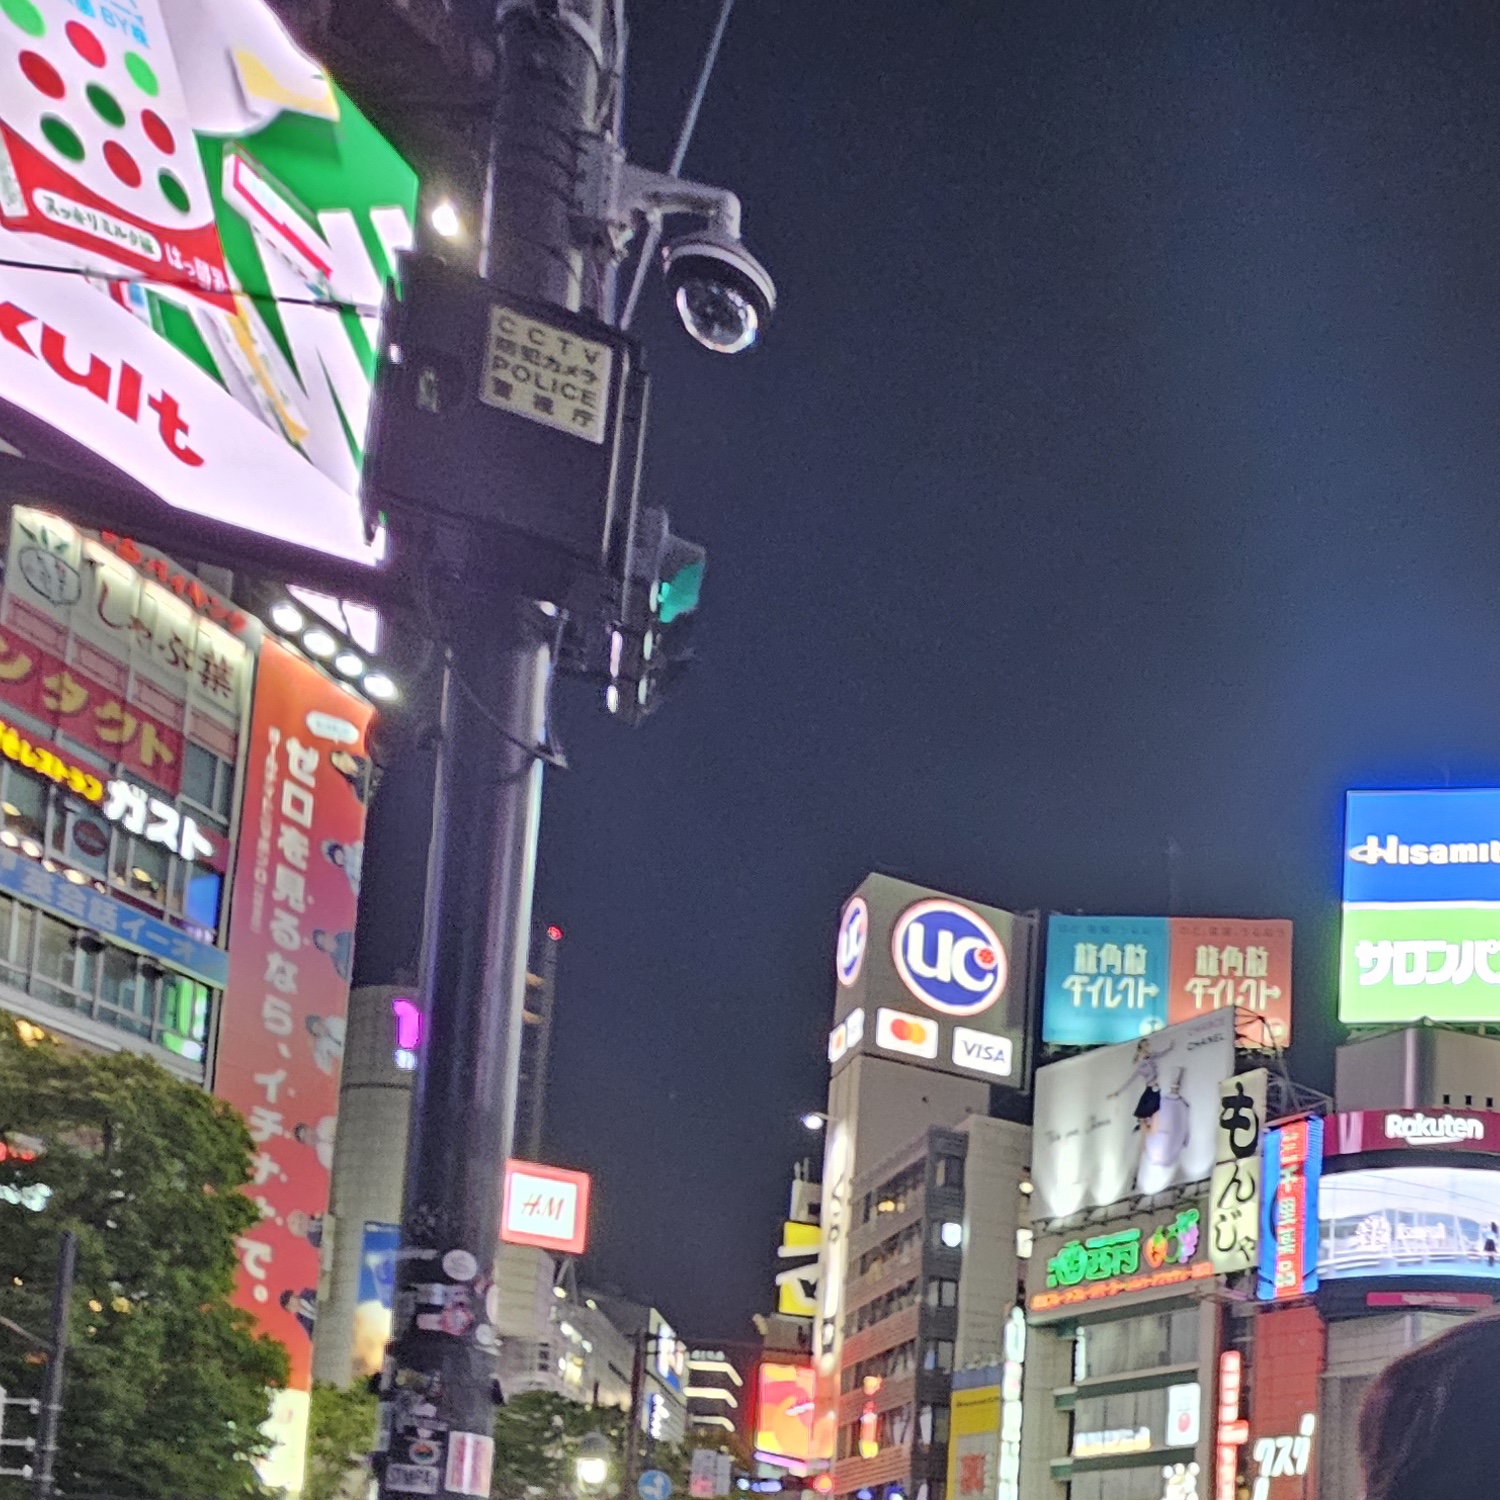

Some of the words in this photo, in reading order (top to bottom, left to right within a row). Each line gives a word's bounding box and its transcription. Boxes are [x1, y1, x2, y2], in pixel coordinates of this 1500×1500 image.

[497, 315, 600, 365] CCTV
[491, 354, 597, 409] POLICE
[103, 778, 215, 862] ガスト
[963, 1039, 1006, 1064] VISA
[1385, 1111, 1485, 1142] Rakuten
[1214, 1081, 1259, 1262] もんじゃ
